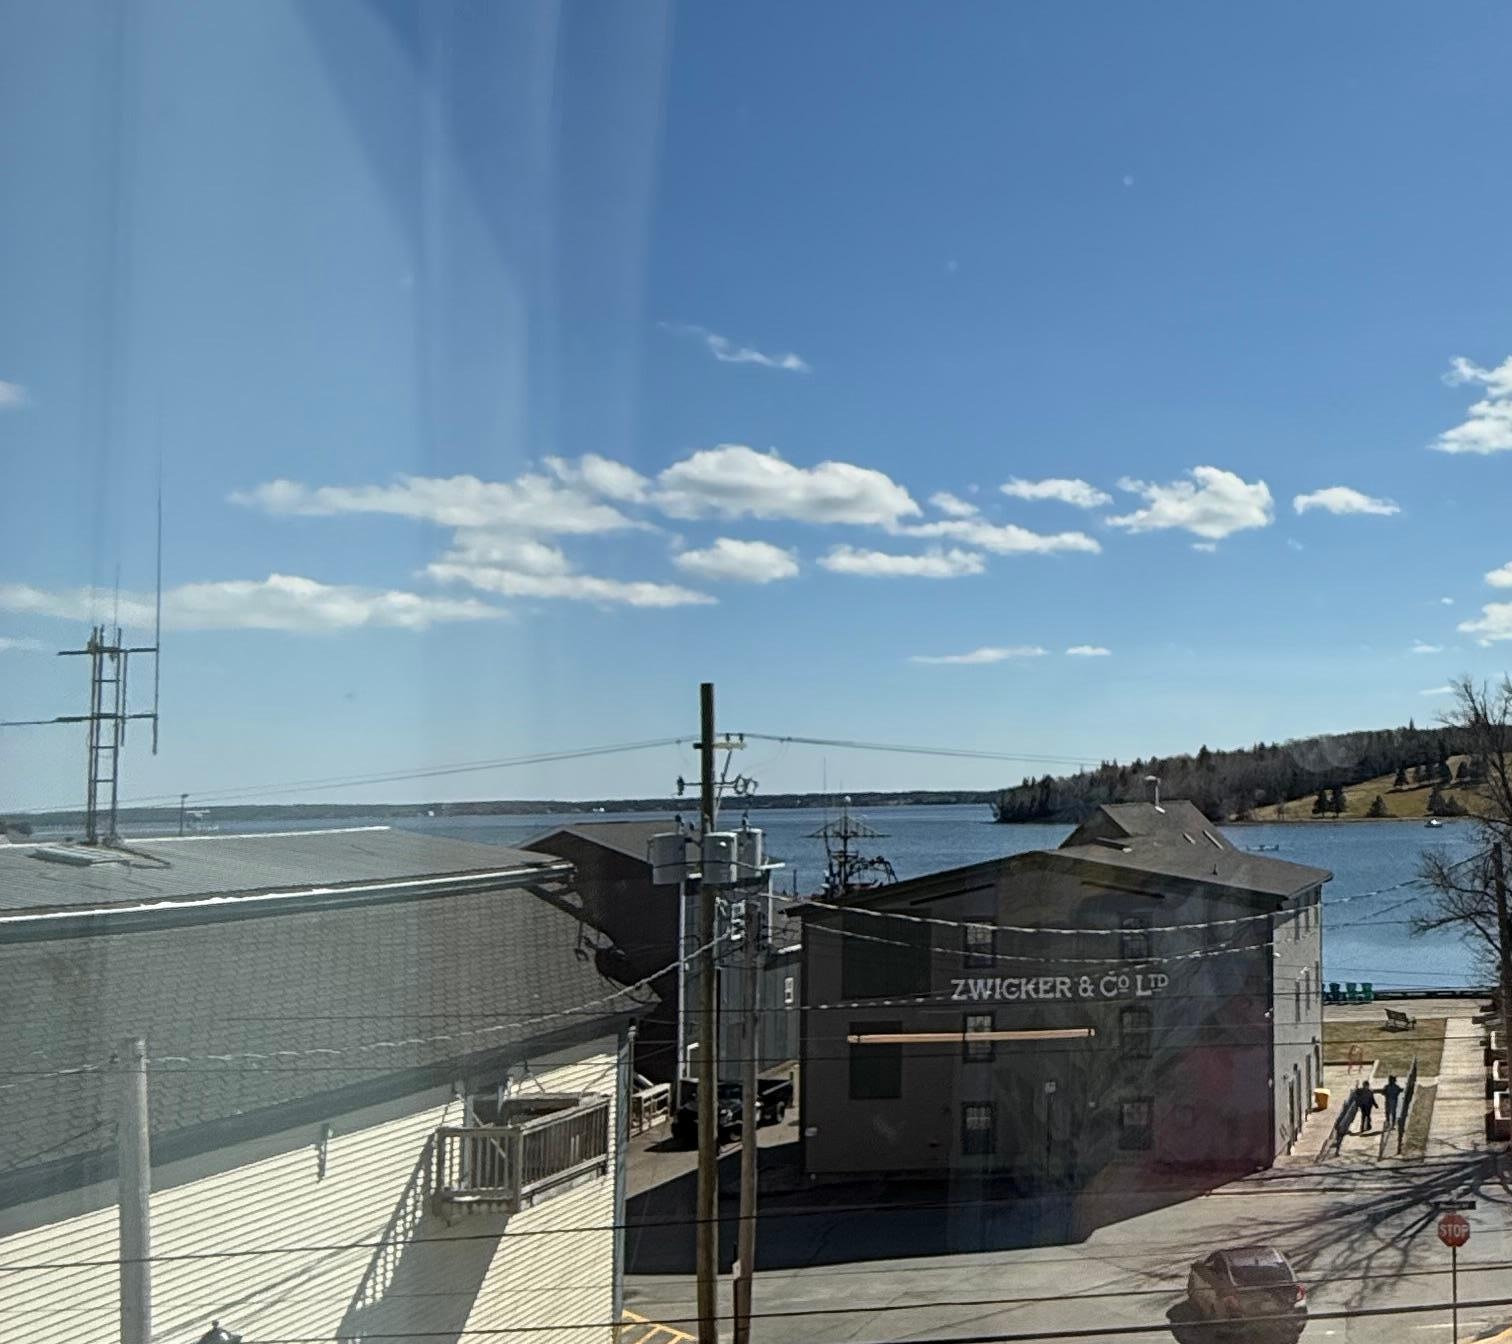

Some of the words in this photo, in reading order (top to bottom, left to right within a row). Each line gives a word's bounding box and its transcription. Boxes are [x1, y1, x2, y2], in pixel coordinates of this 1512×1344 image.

[951, 976, 1073, 1001] ZWICKER
[1078, 975, 1094, 997] &
[1440, 1224, 1469, 1238] STOP
